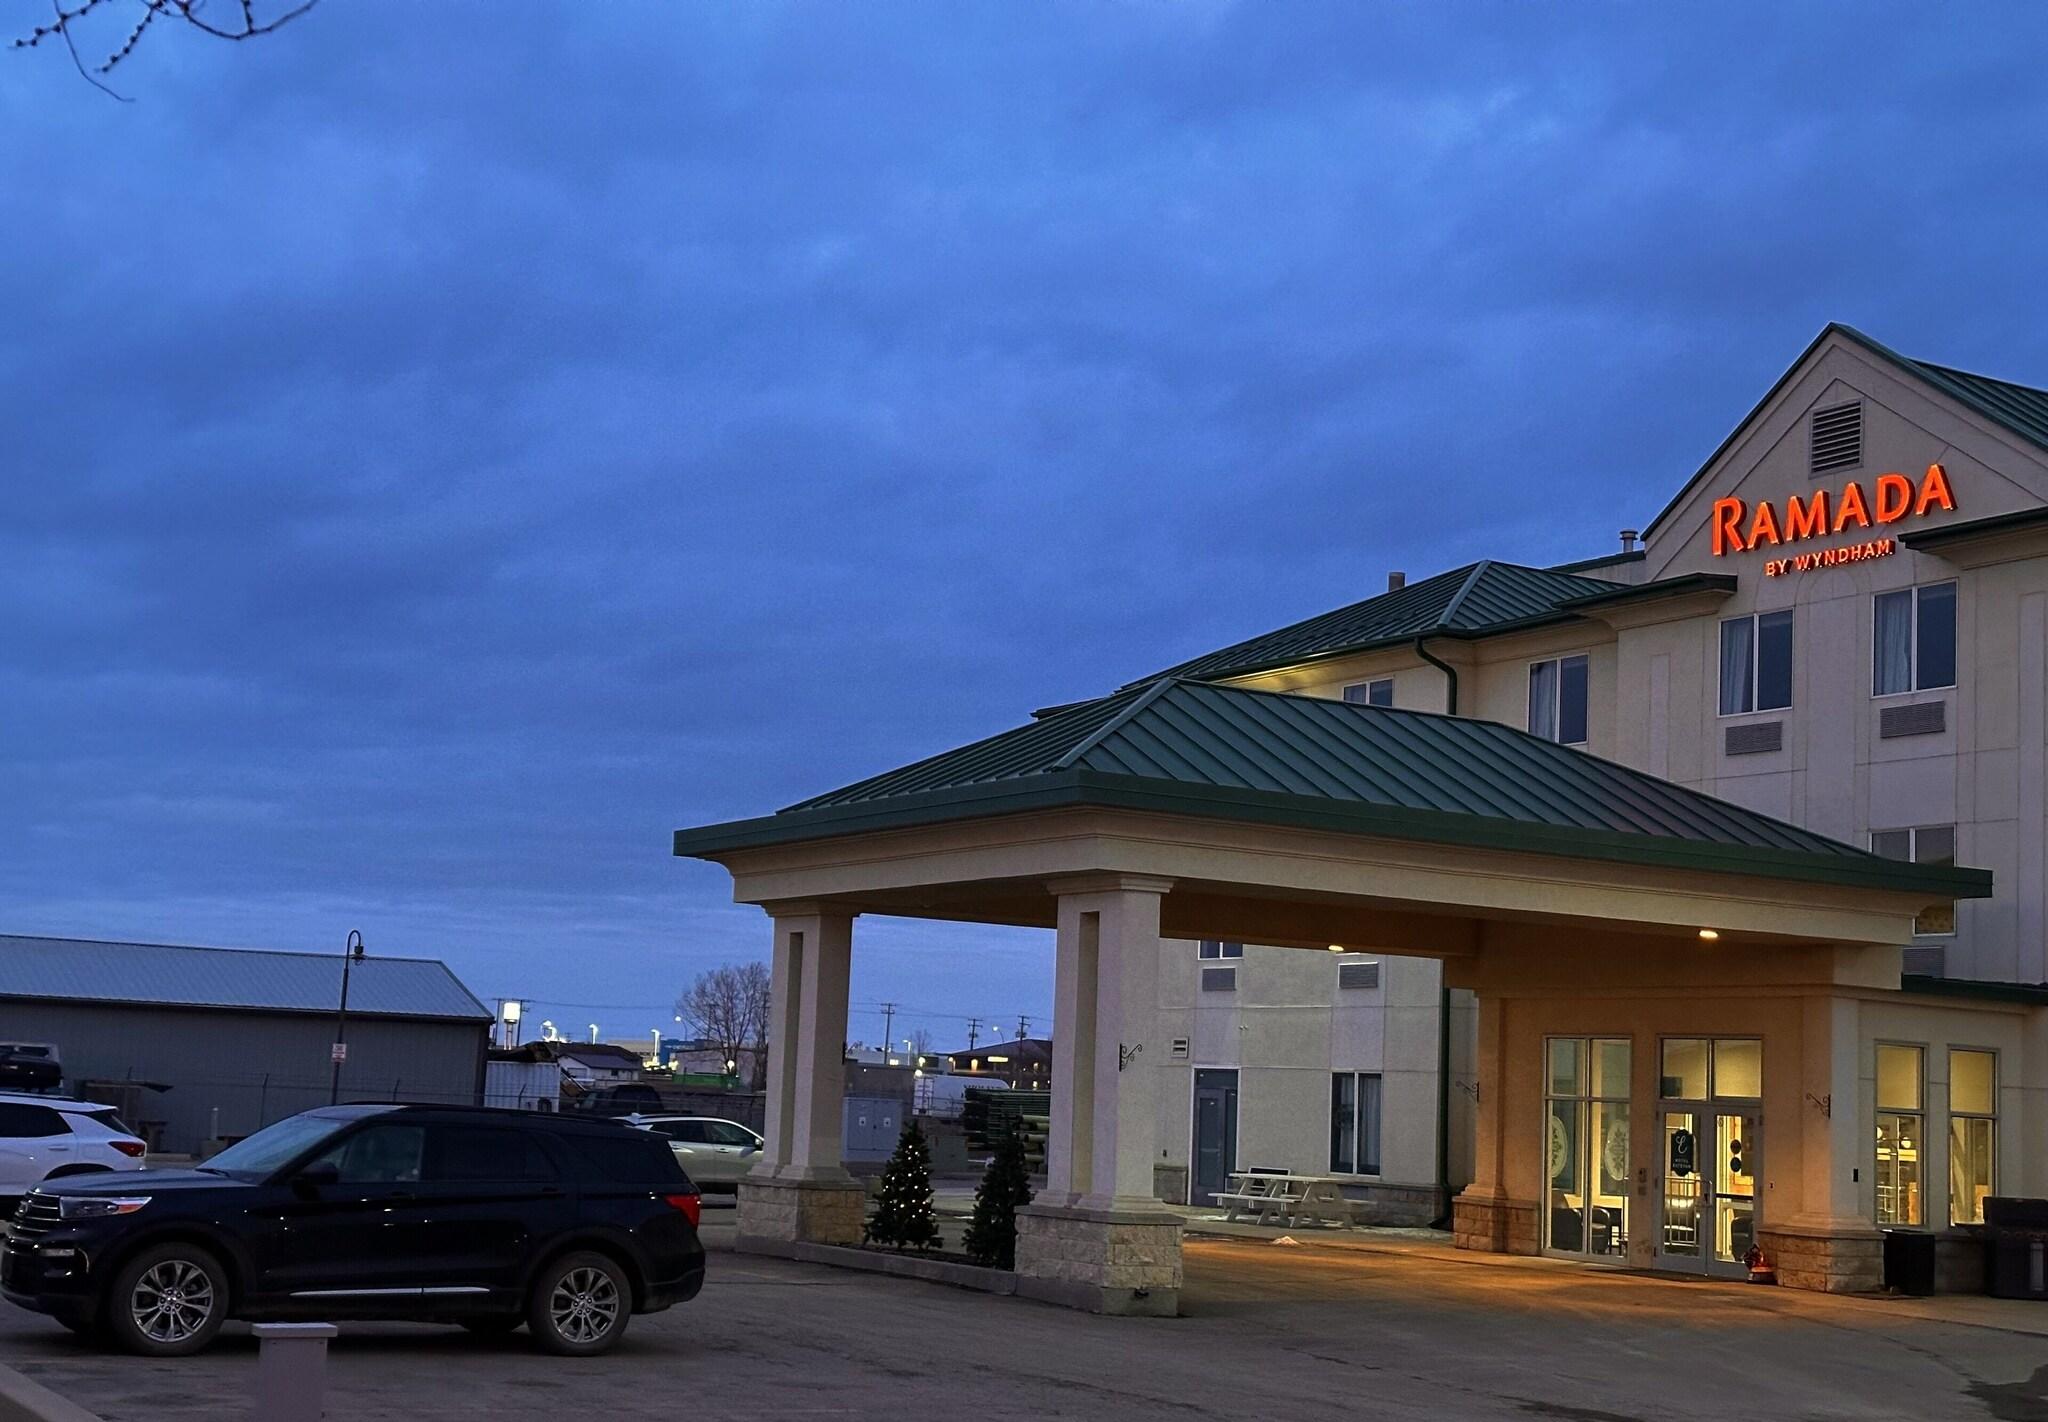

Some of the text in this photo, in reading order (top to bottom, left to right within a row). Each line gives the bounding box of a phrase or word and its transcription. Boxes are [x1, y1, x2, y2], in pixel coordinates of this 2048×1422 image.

[1712, 464, 1956, 556] RAMADA
[1765, 539, 1893, 576] BY WYNDHAM
